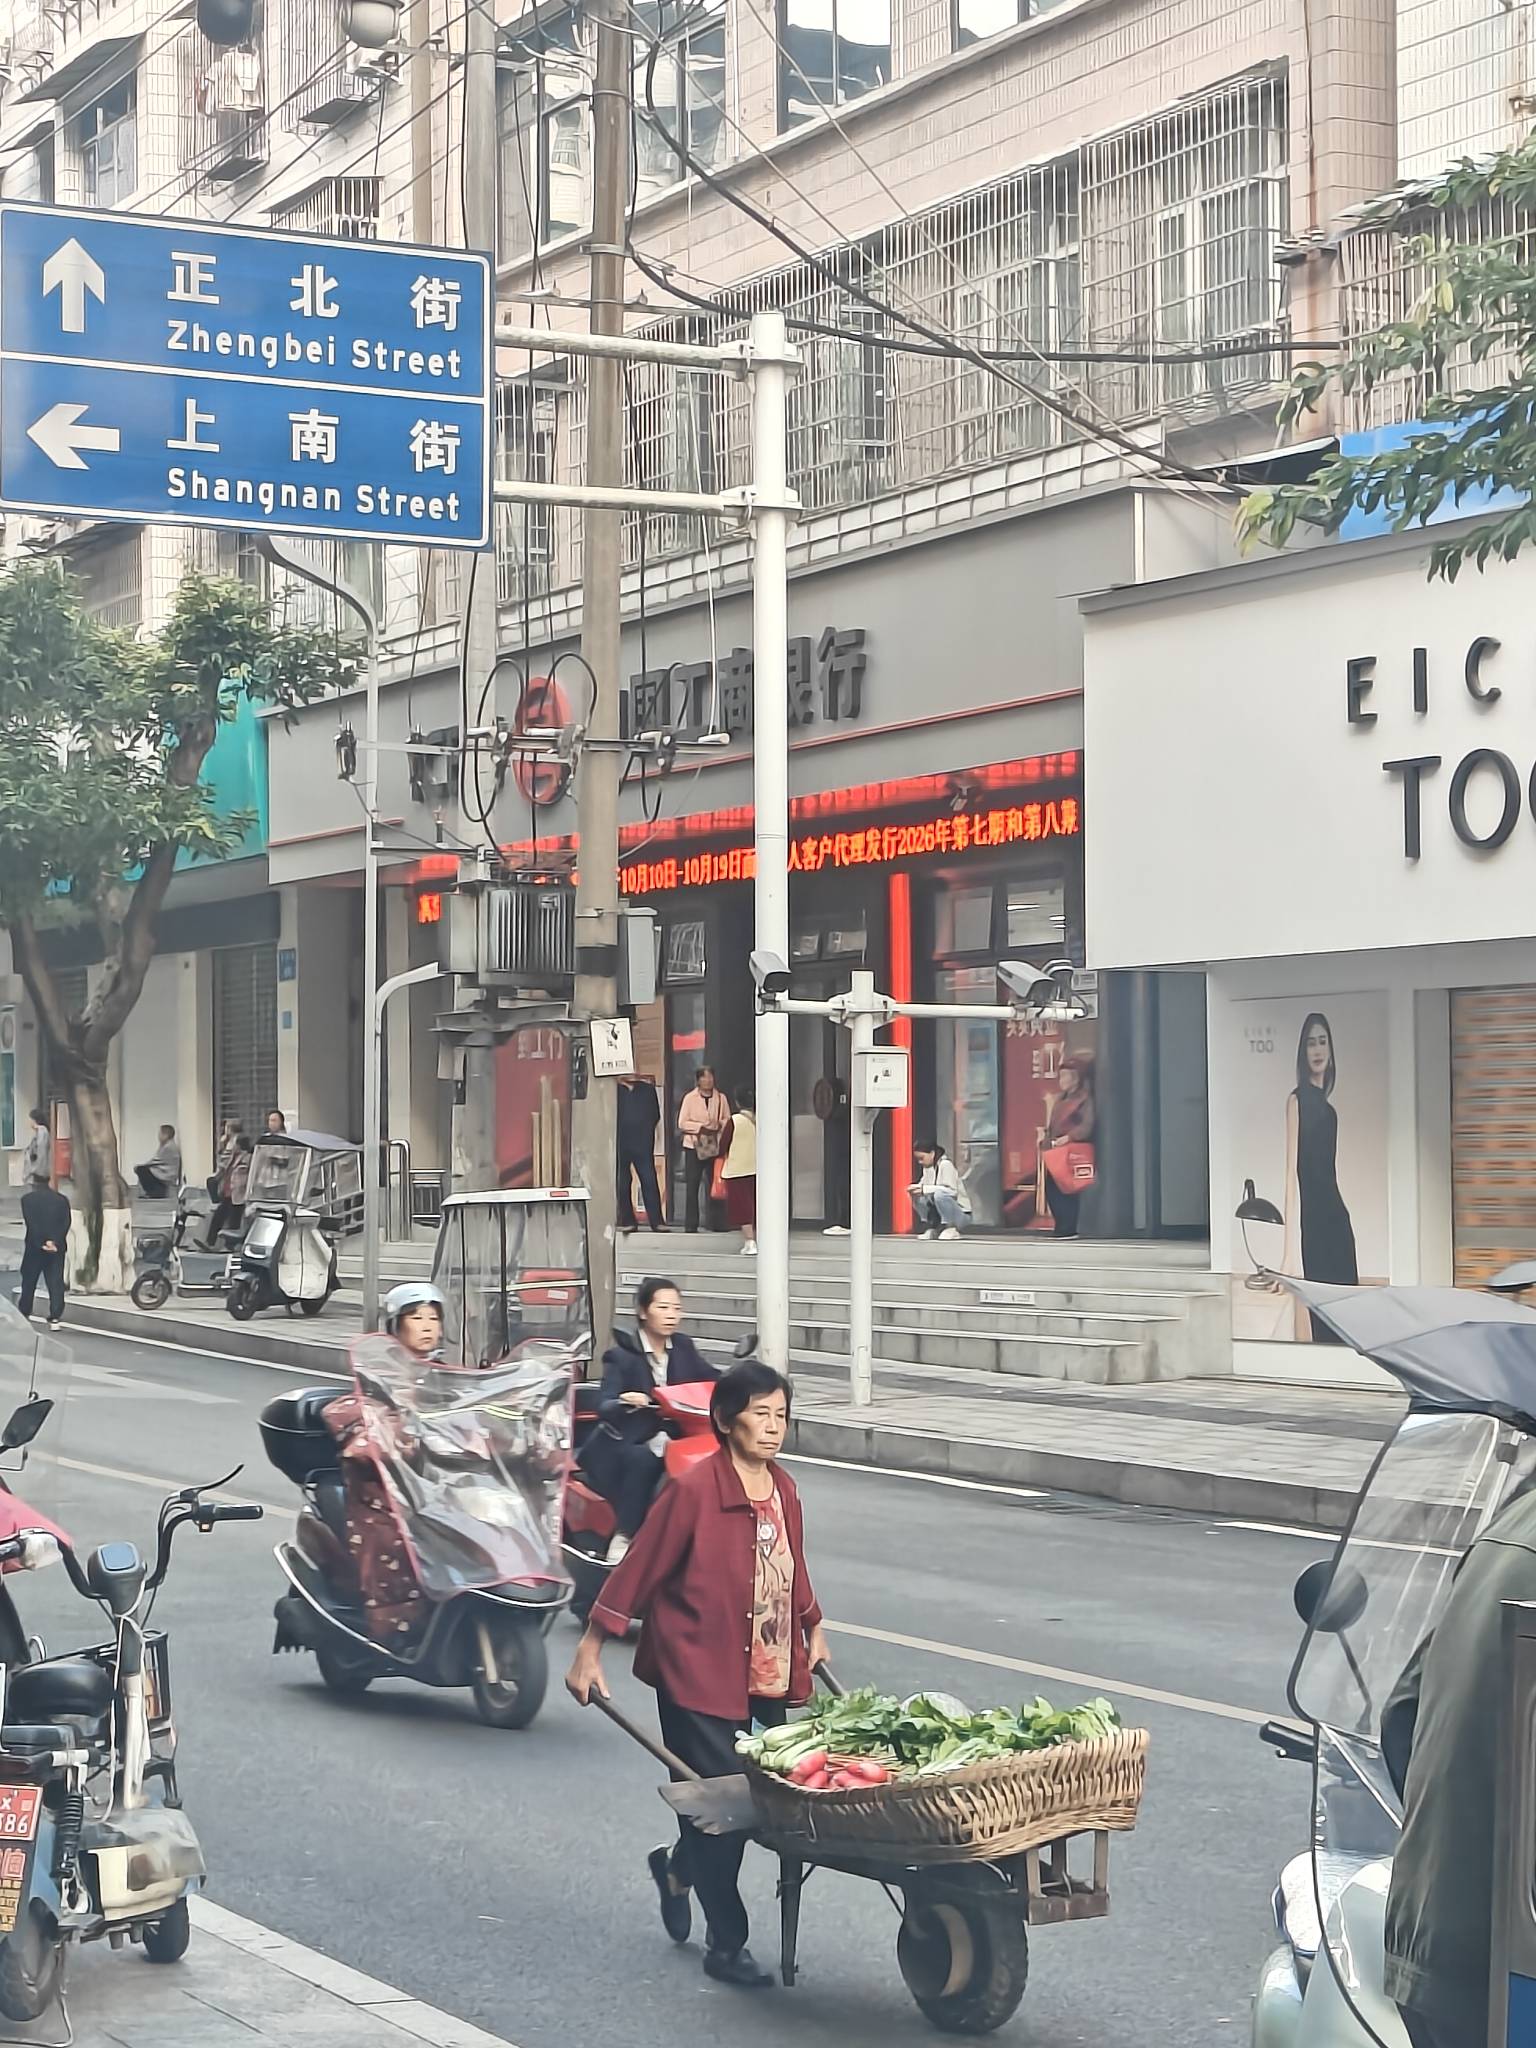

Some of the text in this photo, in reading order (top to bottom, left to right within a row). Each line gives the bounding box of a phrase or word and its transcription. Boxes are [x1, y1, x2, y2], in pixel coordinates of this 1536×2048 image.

[167, 251, 462, 331] 正北街
[167, 320, 461, 378] Zhengbei Street
[167, 398, 461, 475] 上南街
[167, 467, 460, 521] Shangnan Street
[1346, 636, 1502, 724] EIC
[1381, 748, 1536, 860] TO
